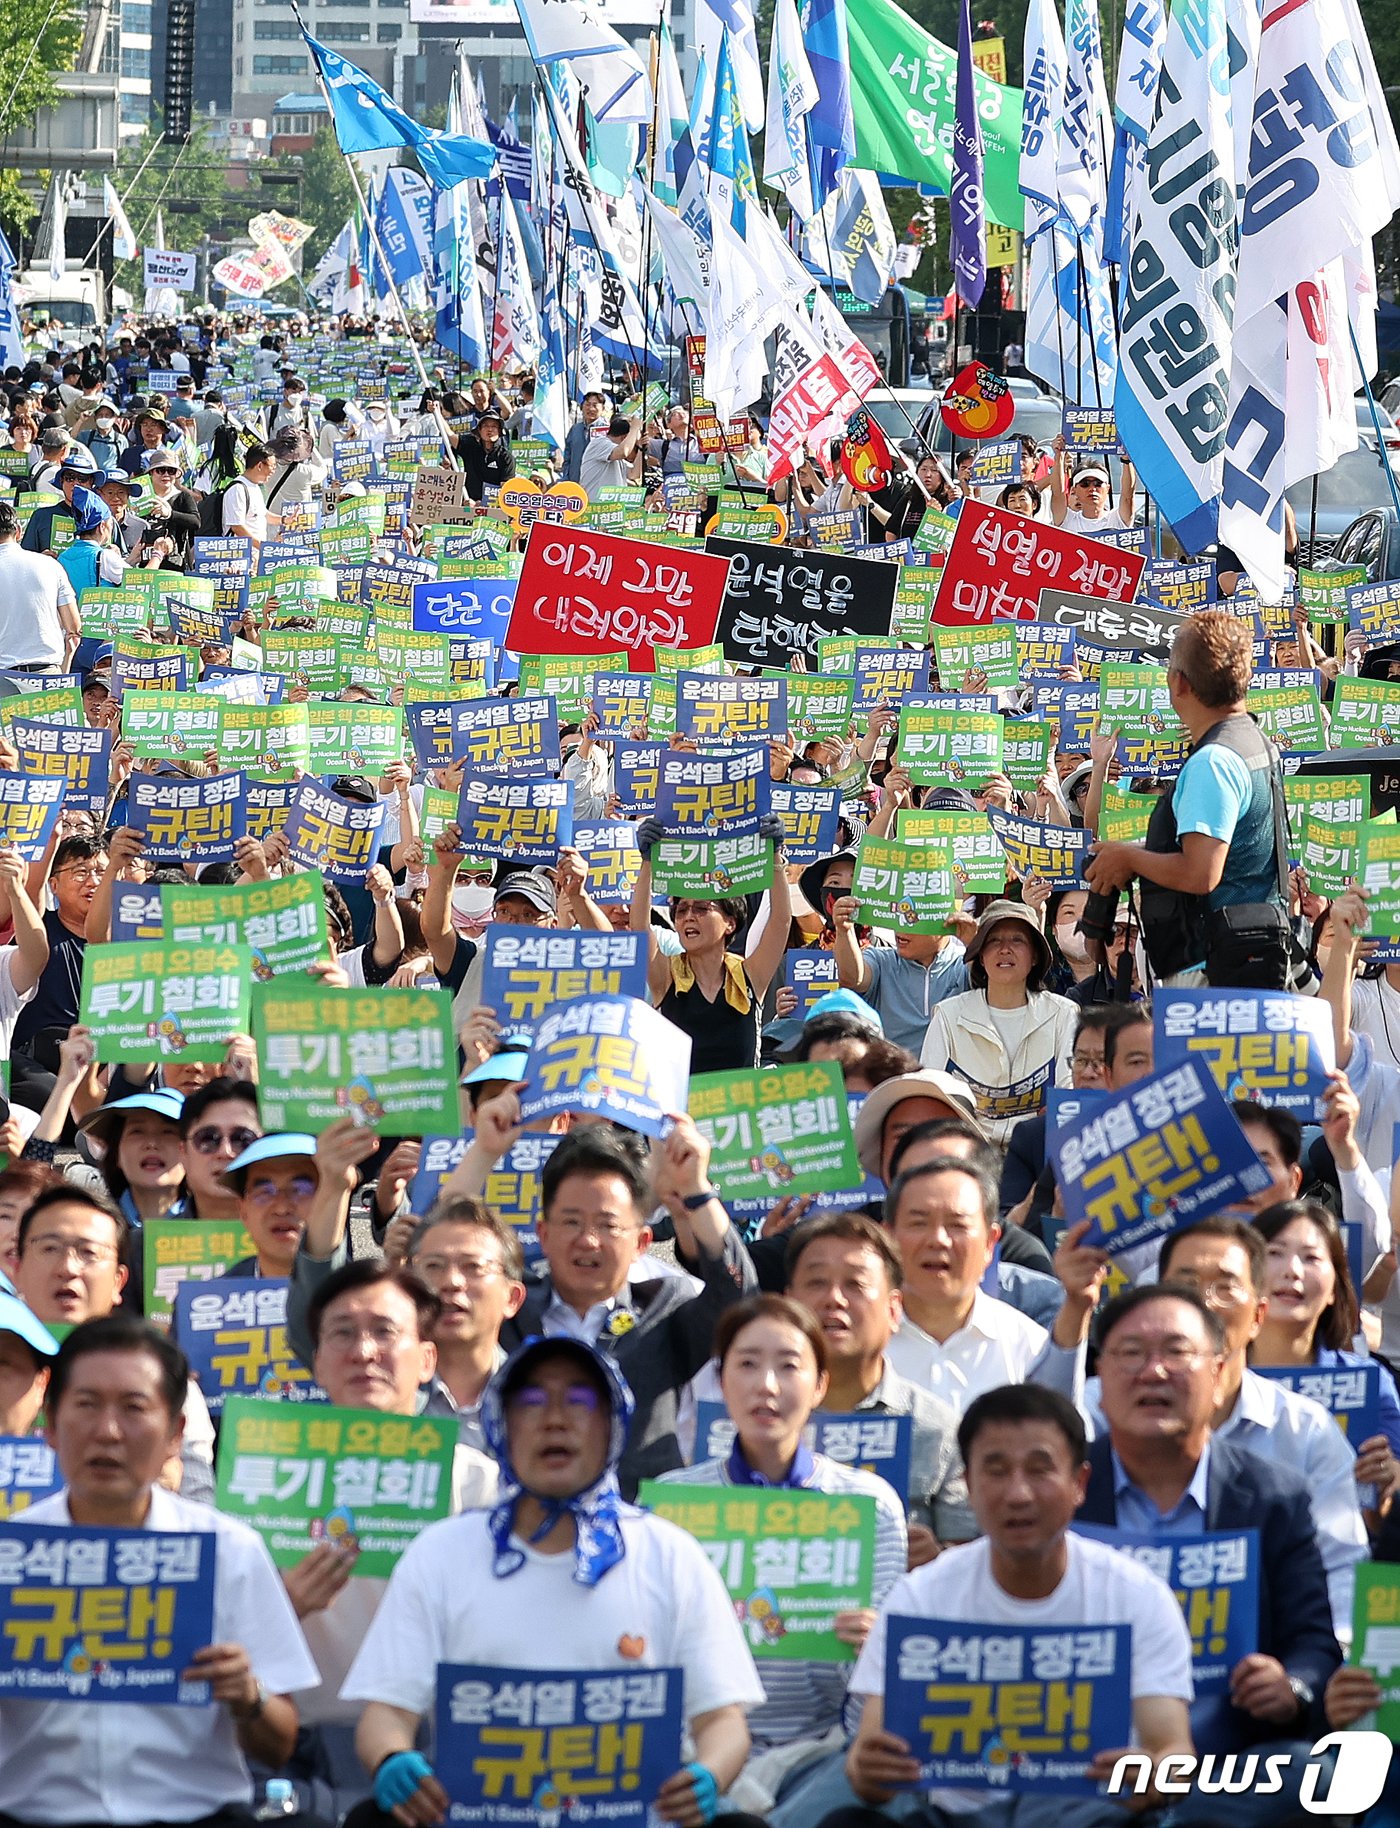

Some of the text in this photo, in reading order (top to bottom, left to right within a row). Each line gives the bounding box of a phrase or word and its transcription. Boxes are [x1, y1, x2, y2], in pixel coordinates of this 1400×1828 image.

[1066, 410, 1100, 423] 윤석열
[1072, 424, 1116, 443] 규탄!
[971, 511, 1132, 601] 석열이 정말
[222, 577, 246, 590] 정권
[542, 542, 693, 606] 이제 그만
[726, 553, 854, 615] 윤석열을
[1188, 564, 1211, 582] 정권
[274, 581, 300, 598] 투기
[1159, 584, 1206, 606] 규탄!
[1351, 588, 1388, 609] 윤석열
[426, 591, 482, 626] 단군
[533, 596, 689, 650] 내려와라
[1043, 626, 1071, 643] 정권
[116, 656, 182, 678] 윤석열 정권
[297, 648, 335, 667] 철회!
[972, 641, 1011, 663] 철회!
[544, 676, 579, 696] 투기
[597, 679, 641, 697] 윤석열
[683, 679, 779, 700] 윤석열 정권
[1283, 671, 1315, 688] 정권
[176, 696, 219, 711] 오염수
[805, 695, 846, 716] 철회!
[1104, 688, 1144, 710] 투기
[1337, 701, 1377, 724] 투기
[127, 711, 218, 731] 투기 철회!
[457, 698, 549, 731] 윤석열 정권
[692, 701, 769, 733] 규탄!
[905, 716, 998, 733] 일본 오염수
[1275, 705, 1316, 729] 철회!
[15, 726, 104, 753] 윤석열 정권
[221, 729, 262, 752] 투기
[350, 725, 396, 746] 철회!
[469, 722, 543, 762] 규탄!
[902, 734, 999, 756] 투기 철회!
[664, 750, 764, 785] 윤석열 정권
[27, 779, 63, 803] 정권
[64, 794, 88, 802] Japan
[136, 779, 241, 809] 윤석열 정권
[467, 781, 568, 808] 윤석열 정권
[672, 779, 756, 822] 규탄!
[794, 791, 834, 811] 정권
[1315, 780, 1362, 801] 오염수
[298, 786, 385, 830] 윤석열 정권
[1309, 799, 1363, 825] 철회!
[147, 803, 232, 844] 규탄!
[473, 806, 559, 845] 규탄!
[574, 826, 633, 850] 윤석열
[904, 819, 935, 835] 일본
[992, 814, 1083, 849] 윤석열 정권
[297, 813, 375, 865] 규탄!
[658, 834, 767, 867] 투기 철회!
[952, 836, 1004, 858] 철회!
[1305, 842, 1349, 871] 투기
[856, 866, 951, 896] 투기 철회!
[1052, 878, 1077, 886] Japan
[865, 896, 889, 907] Nuclear
[872, 909, 896, 919] Ocean
[243, 902, 317, 949] 철회!
[141, 946, 240, 977] 핵 오염수
[492, 936, 637, 969] 윤석열 정권
[88, 975, 241, 1018] 투기 철회!
[351, 995, 440, 1028] 오염수
[535, 1001, 626, 1052] 윤석열
[1164, 999, 1258, 1037] 윤석열
[120, 1036, 157, 1049] Ocean
[266, 1028, 444, 1080] 투기 철회!
[759, 1068, 831, 1103] 오염수
[307, 1097, 443, 1119] Ocean dumping
[756, 1096, 840, 1145] 철회!
[1060, 1062, 1207, 1186] 윤석열 정권
[1082, 1114, 1220, 1234] 규탄!
[189, 1287, 289, 1331] 윤석열
[236, 1418, 443, 1456] 일본 오염수
[822, 1419, 899, 1461] 정권
[228, 1455, 443, 1510] 투기 철회!
[760, 1501, 861, 1536] 오염수
[0, 1536, 201, 1586] 윤석열 정권
[752, 1538, 861, 1588] 철회!
[1178, 1535, 1249, 1586] 정권
[3, 1585, 177, 1662] 규탄!
[898, 1629, 1118, 1682] 윤석열 정권
[449, 1672, 669, 1726] 윤석열 정권
[919, 1681, 1094, 1755] 규탄!
[472, 1722, 644, 1801] 규탄!
